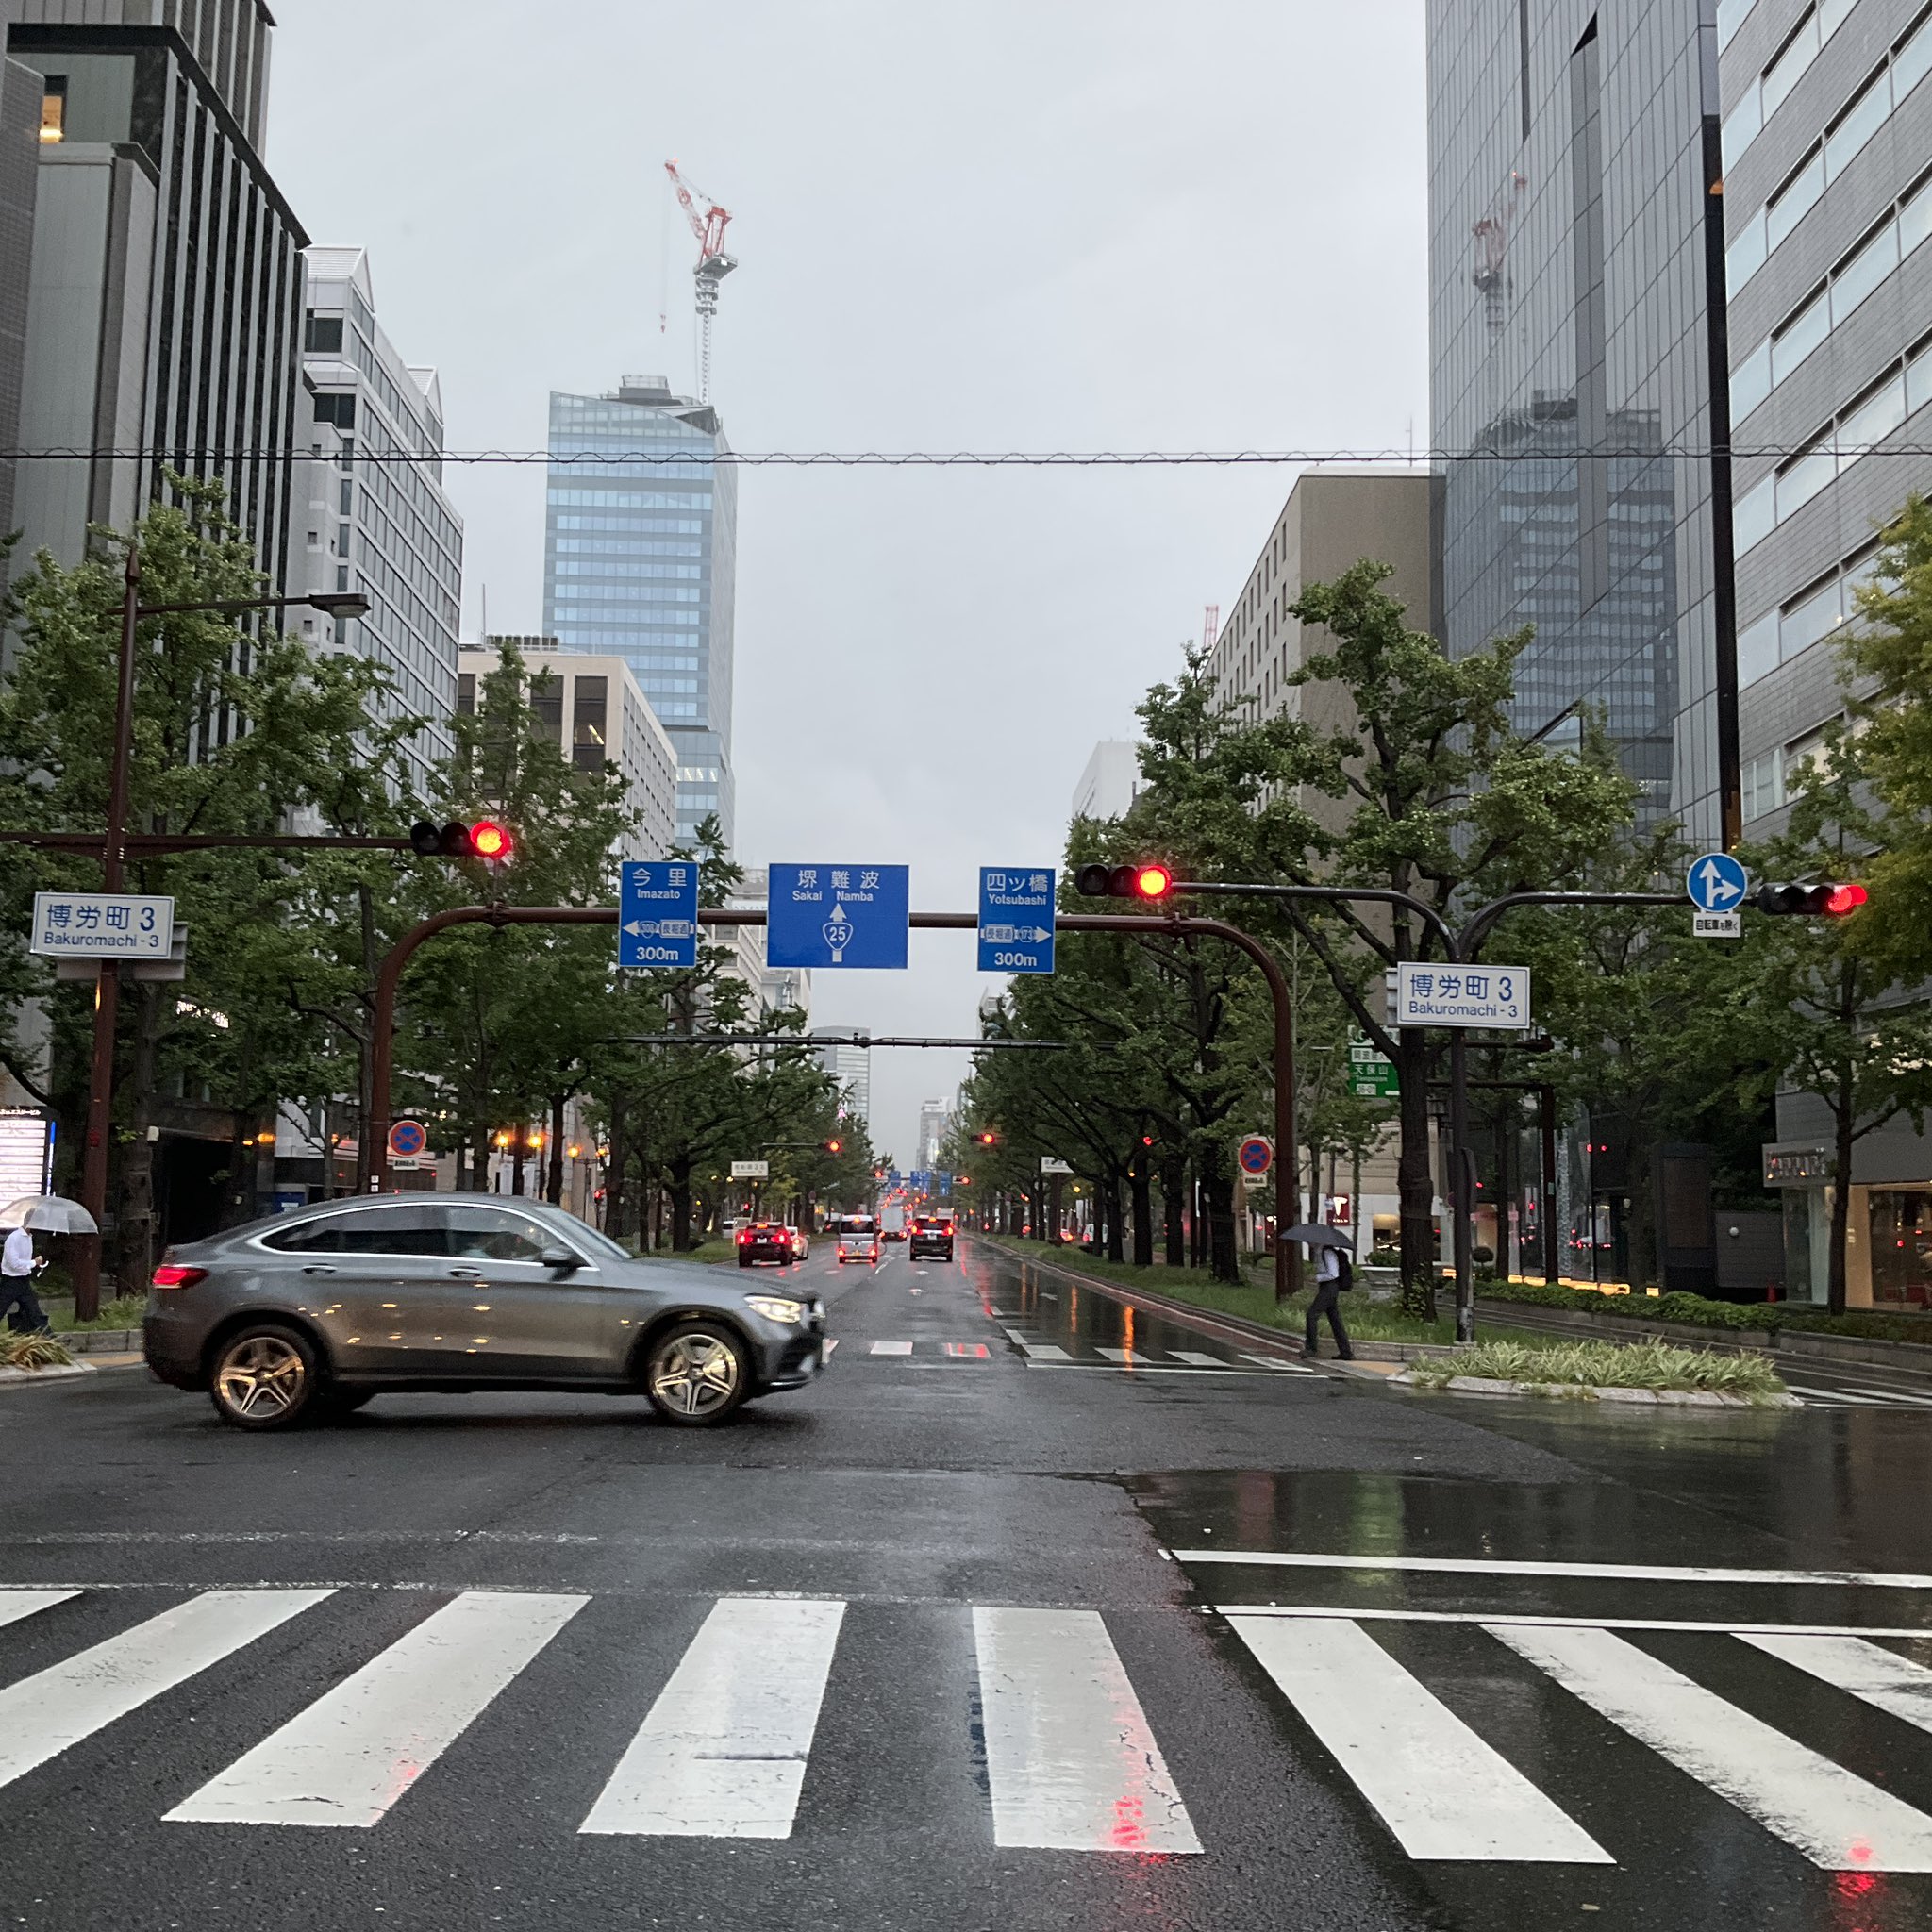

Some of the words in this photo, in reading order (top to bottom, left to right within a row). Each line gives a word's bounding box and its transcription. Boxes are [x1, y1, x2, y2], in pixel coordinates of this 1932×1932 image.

[632, 867, 687, 887] 今里
[987, 874, 1048, 893] 四ツ橋
[637, 889, 681, 899] Imazato
[792, 890, 823, 901] Sakai
[836, 891, 874, 902] Namba
[989, 893, 1047, 906] Yotsubashi
[1696, 919, 1739, 931] 自転車を除く
[44, 931, 137, 947] Bakuromachi
[149, 935, 158, 948] 3
[829, 926, 847, 941] 25
[636, 946, 679, 960] 300m
[994, 952, 1038, 966] 300m
[1408, 1000, 1497, 1017] Bakuromachi
[1508, 1005, 1518, 1018] 3
